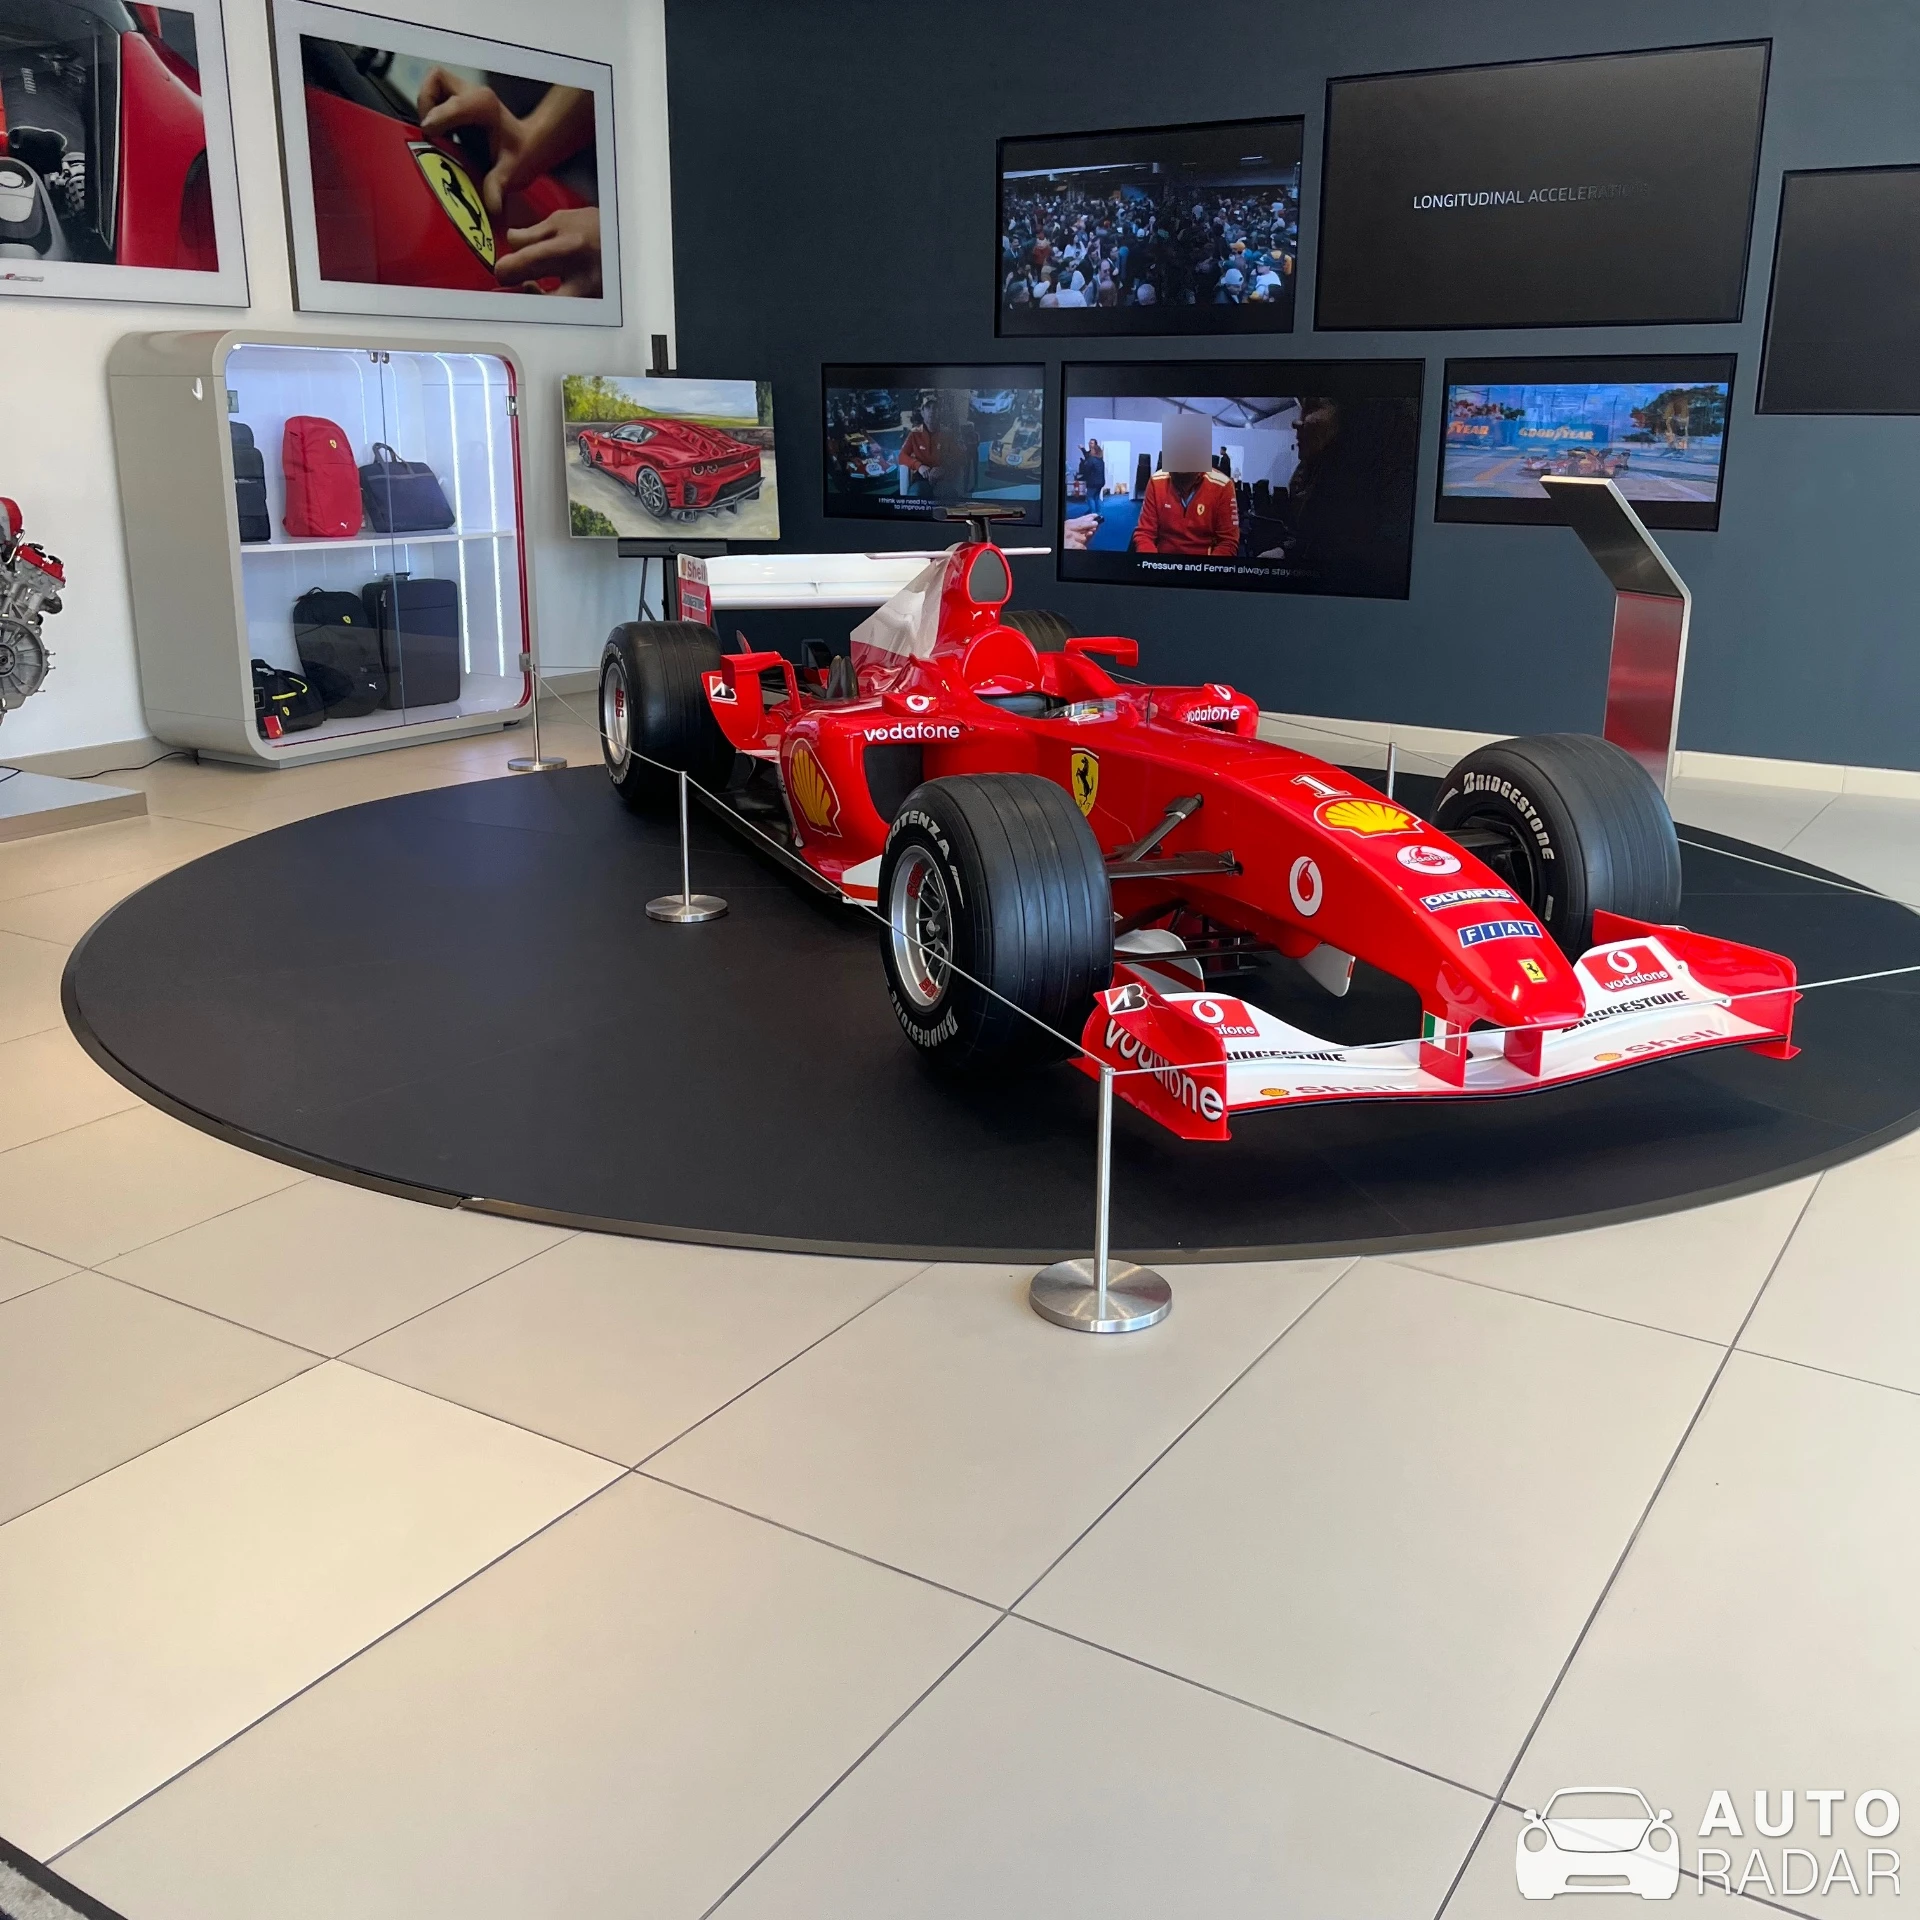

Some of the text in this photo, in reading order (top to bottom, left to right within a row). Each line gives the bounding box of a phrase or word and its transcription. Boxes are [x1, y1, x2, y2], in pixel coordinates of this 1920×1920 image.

[1413, 181, 1648, 209] LONGITUDINAL ACCELERATI
[687, 560, 707, 581] Shell
[1142, 560, 1183, 571] Pressure
[1184, 562, 1202, 572] and
[1203, 563, 1236, 574] Ferrari
[1237, 566, 1270, 576] always
[1271, 568, 1291, 577] stay
[1186, 704, 1240, 722] vodafone
[864, 722, 960, 742] vodafone
[1290, 774, 1353, 799] 1
[1462, 771, 1555, 861] BRIDGESTONE
[1424, 888, 1512, 906] OLYMPUS
[1465, 922, 1535, 943] FIAT
[1604, 970, 1669, 991] vodafone
[1625, 1029, 1724, 1054] Shell
[1295, 1084, 1401, 1095] Shell
